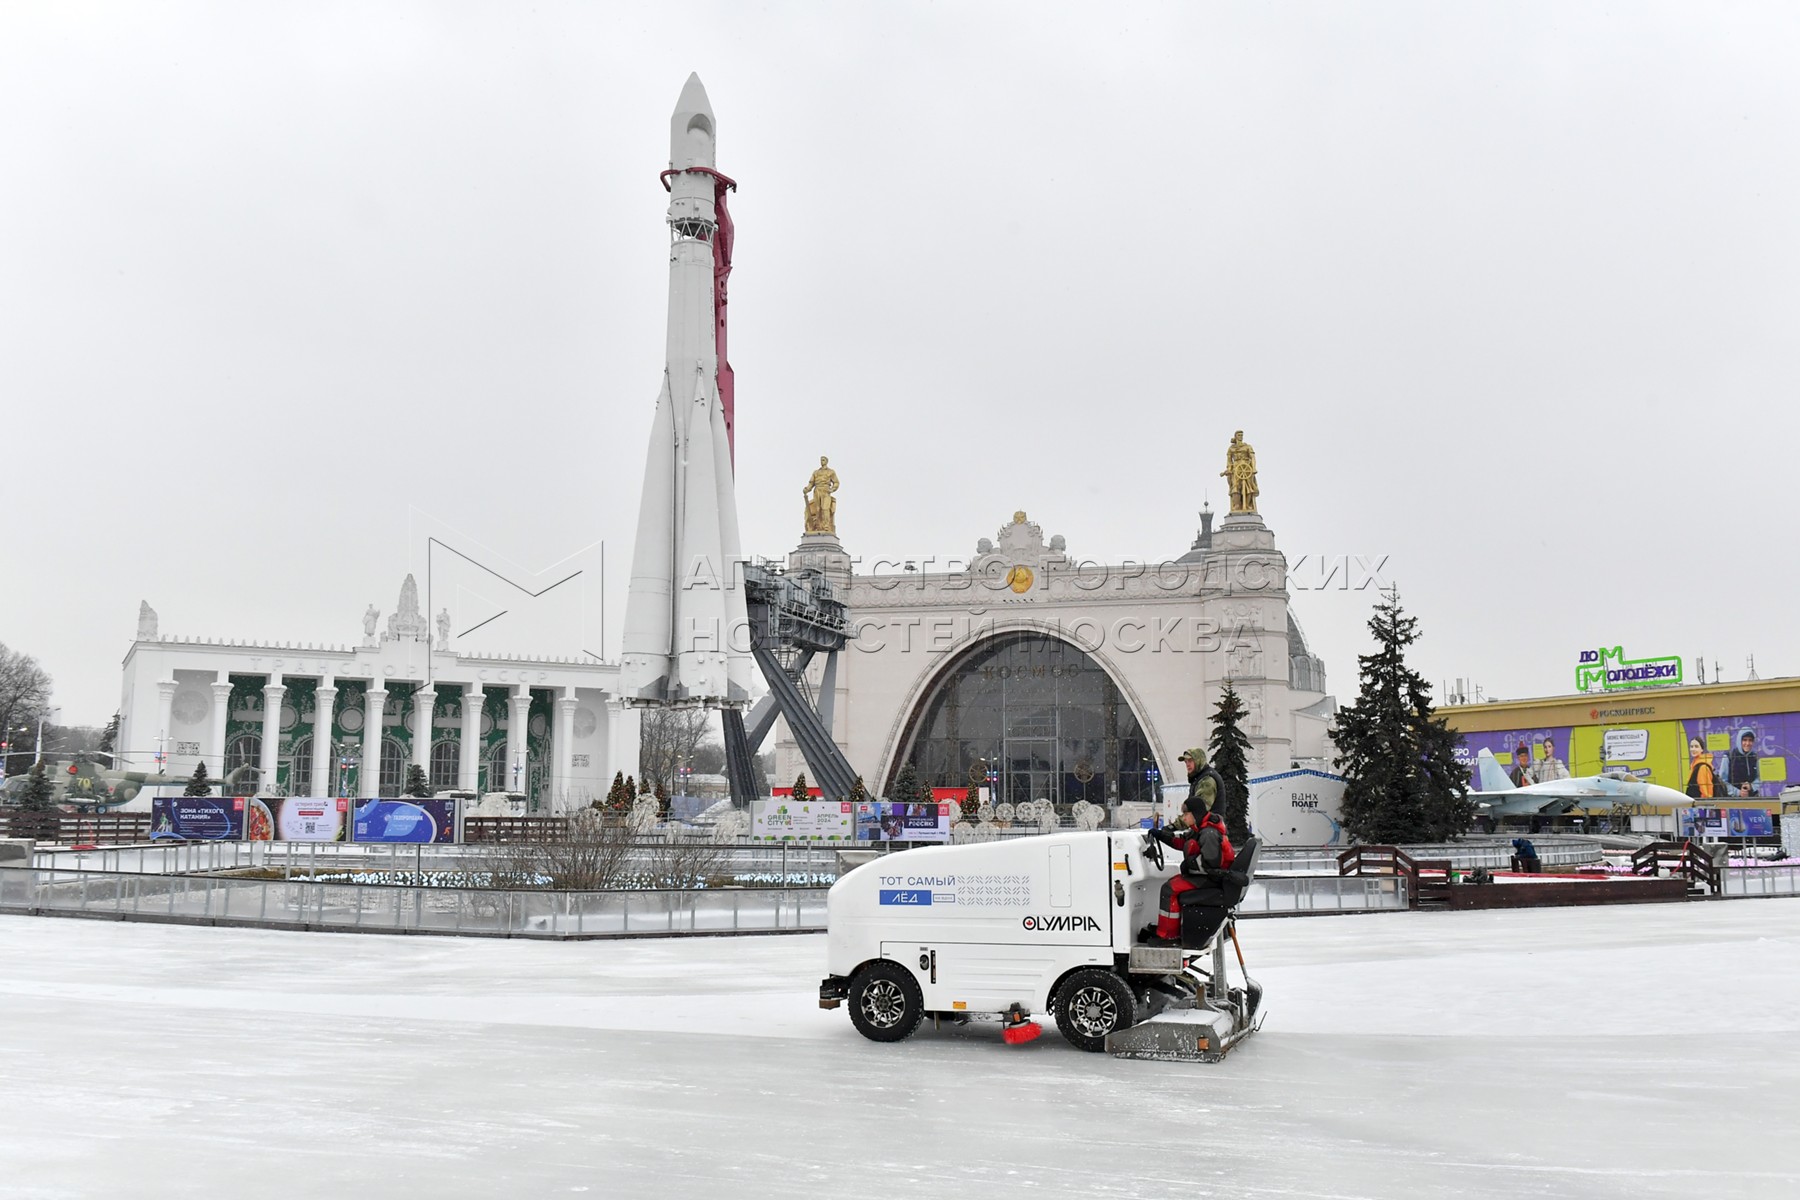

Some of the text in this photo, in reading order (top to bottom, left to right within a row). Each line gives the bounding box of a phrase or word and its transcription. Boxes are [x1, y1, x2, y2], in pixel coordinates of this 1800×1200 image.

[250, 658, 548, 683] ТРАНСПОРТ СССР
[983, 664, 1079, 680] КОСМОС
[1599, 707, 1655, 717] РОСКОНГРЕСС
[77, 778, 91, 788] 70
[879, 875, 956, 886] ТОТ САМЫЙ
[892, 891, 919, 903] ЛЁД
[1022, 915, 1102, 931] OLYMPIA
